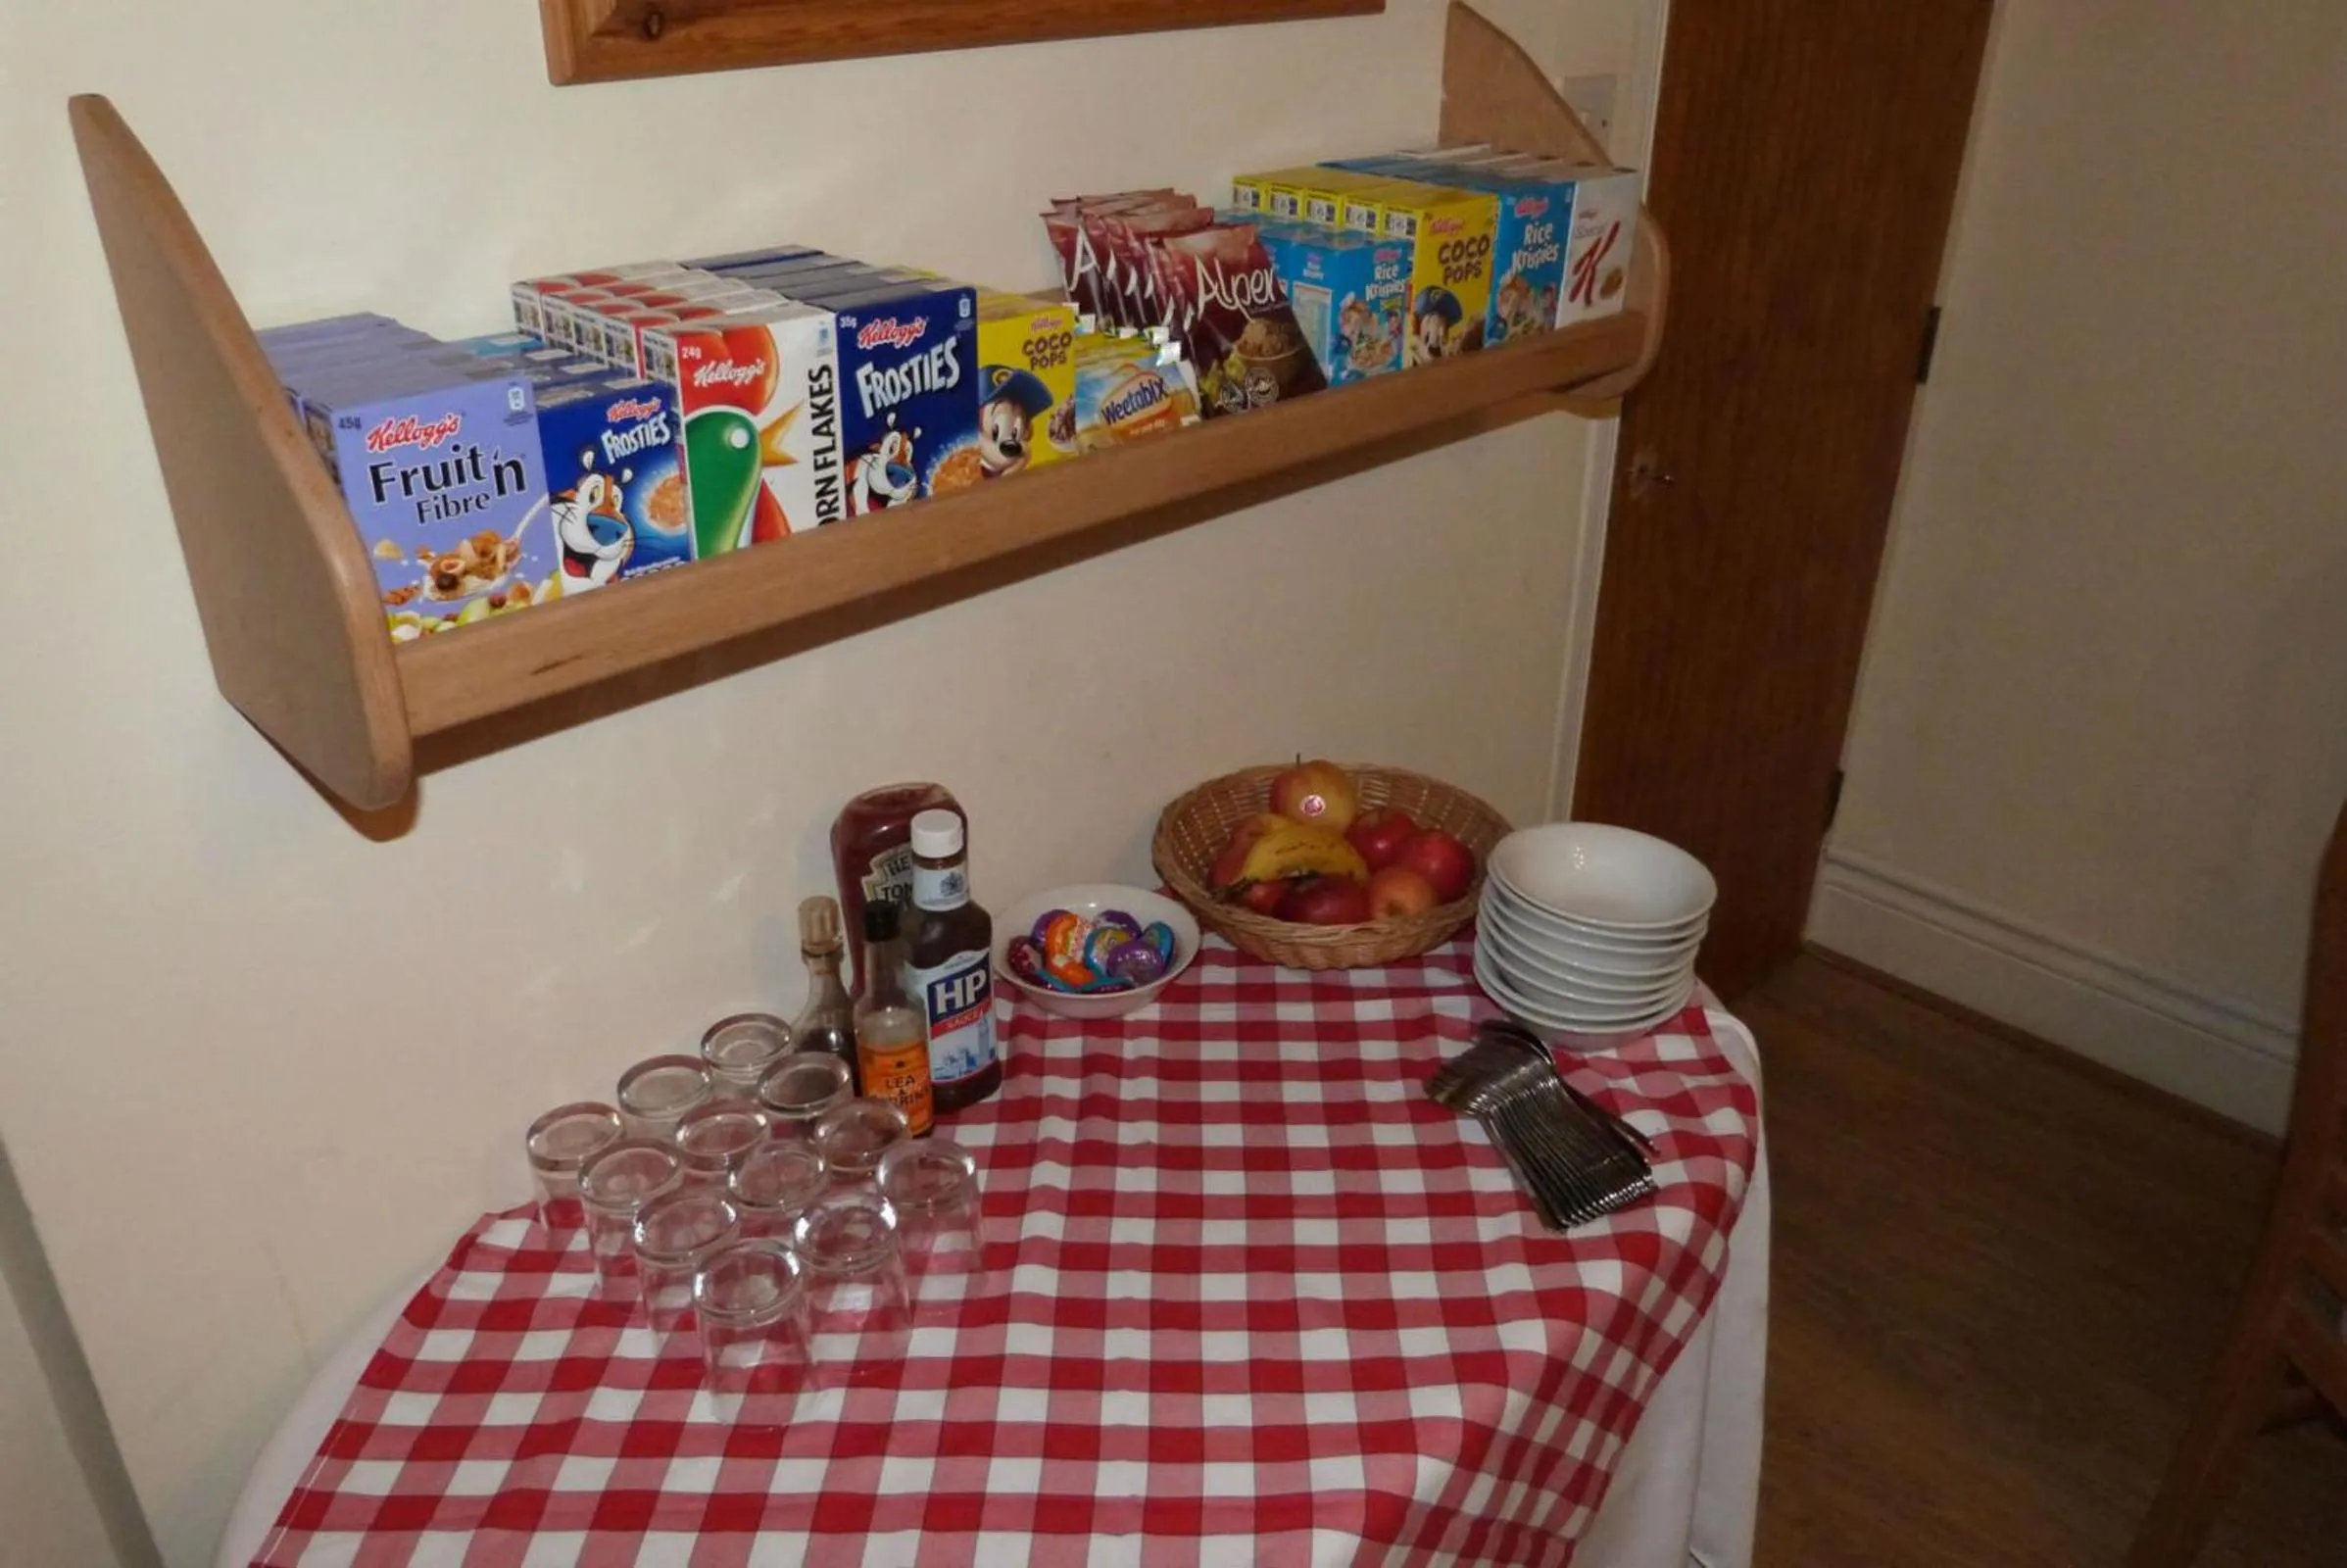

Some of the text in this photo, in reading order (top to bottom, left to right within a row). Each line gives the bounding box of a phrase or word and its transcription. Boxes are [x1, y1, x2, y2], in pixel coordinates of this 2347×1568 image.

[1524, 220, 1553, 244] Rice
[1438, 233, 1491, 265] COCO
[1374, 263, 1400, 280] Rice
[1442, 260, 1482, 286] POPS
[857, 317, 927, 350] Kellogg's
[1022, 331, 1072, 357] COCO
[693, 358, 766, 387] Kellogg's
[856, 335, 960, 418] FROSTIES
[1030, 351, 1067, 371] POPS
[807, 364, 837, 471] FLAKES
[1101, 377, 1168, 425] Weetabix
[367, 412, 462, 454] Kellogg's
[601, 411, 671, 465] FROSTIES
[368, 444, 486, 504] Fruit
[416, 492, 491, 525] Fibre
[935, 968, 987, 1015] HP
[886, 1074, 915, 1089] LEA
